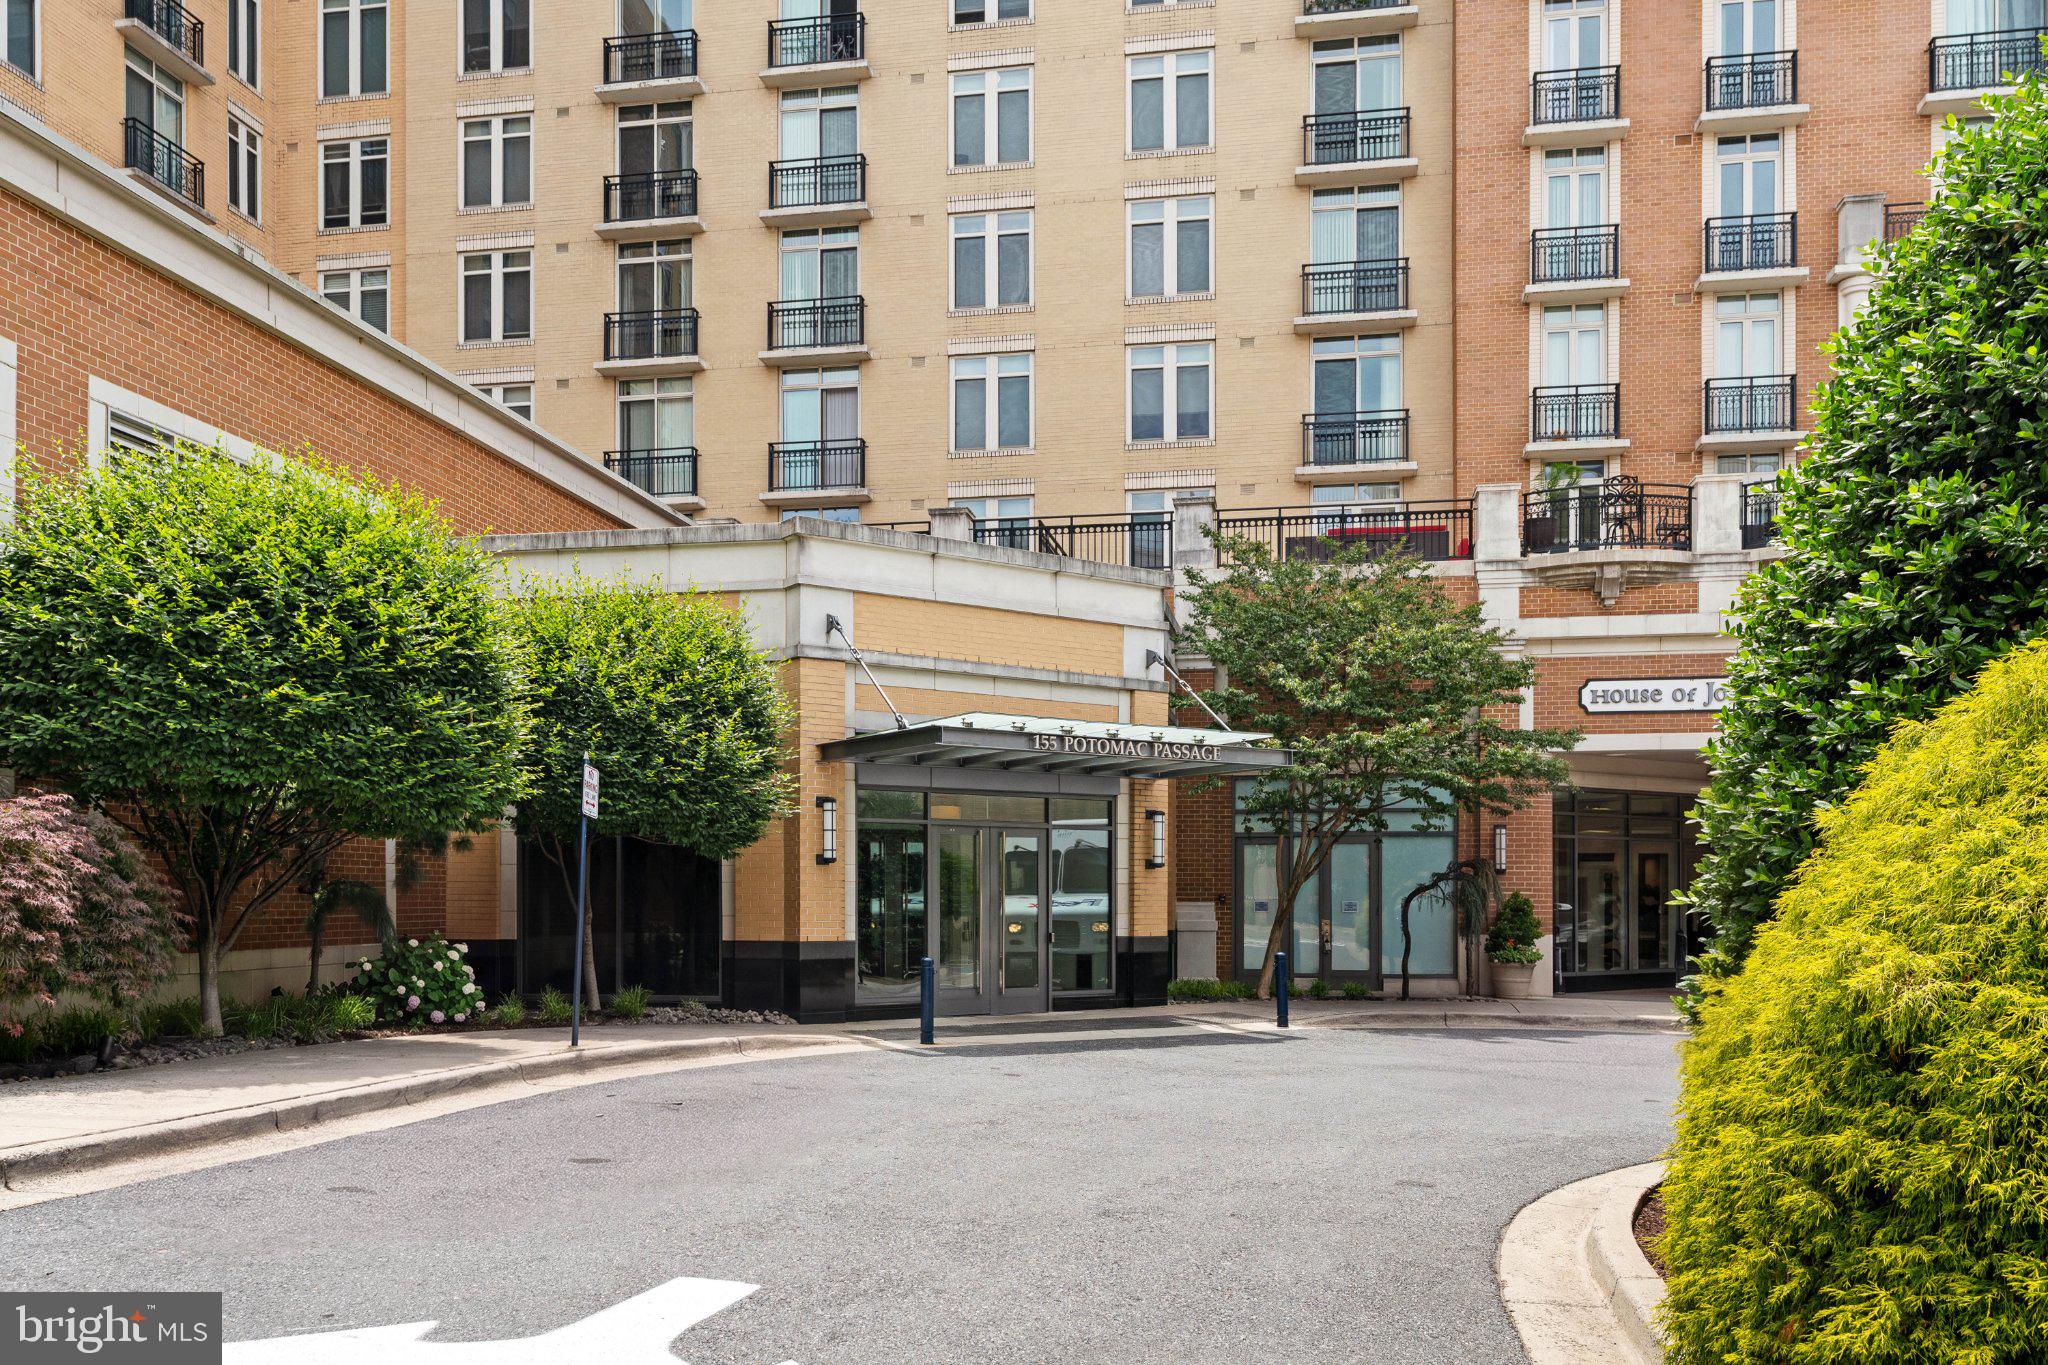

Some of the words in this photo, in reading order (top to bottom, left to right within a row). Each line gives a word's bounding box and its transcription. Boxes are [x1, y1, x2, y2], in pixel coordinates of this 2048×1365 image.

[1590, 689, 1663, 704] House
[1033, 734, 1057, 751] 155
[1064, 736, 1148, 757] POTOMAC
[1153, 743, 1222, 761] PASSAGE
